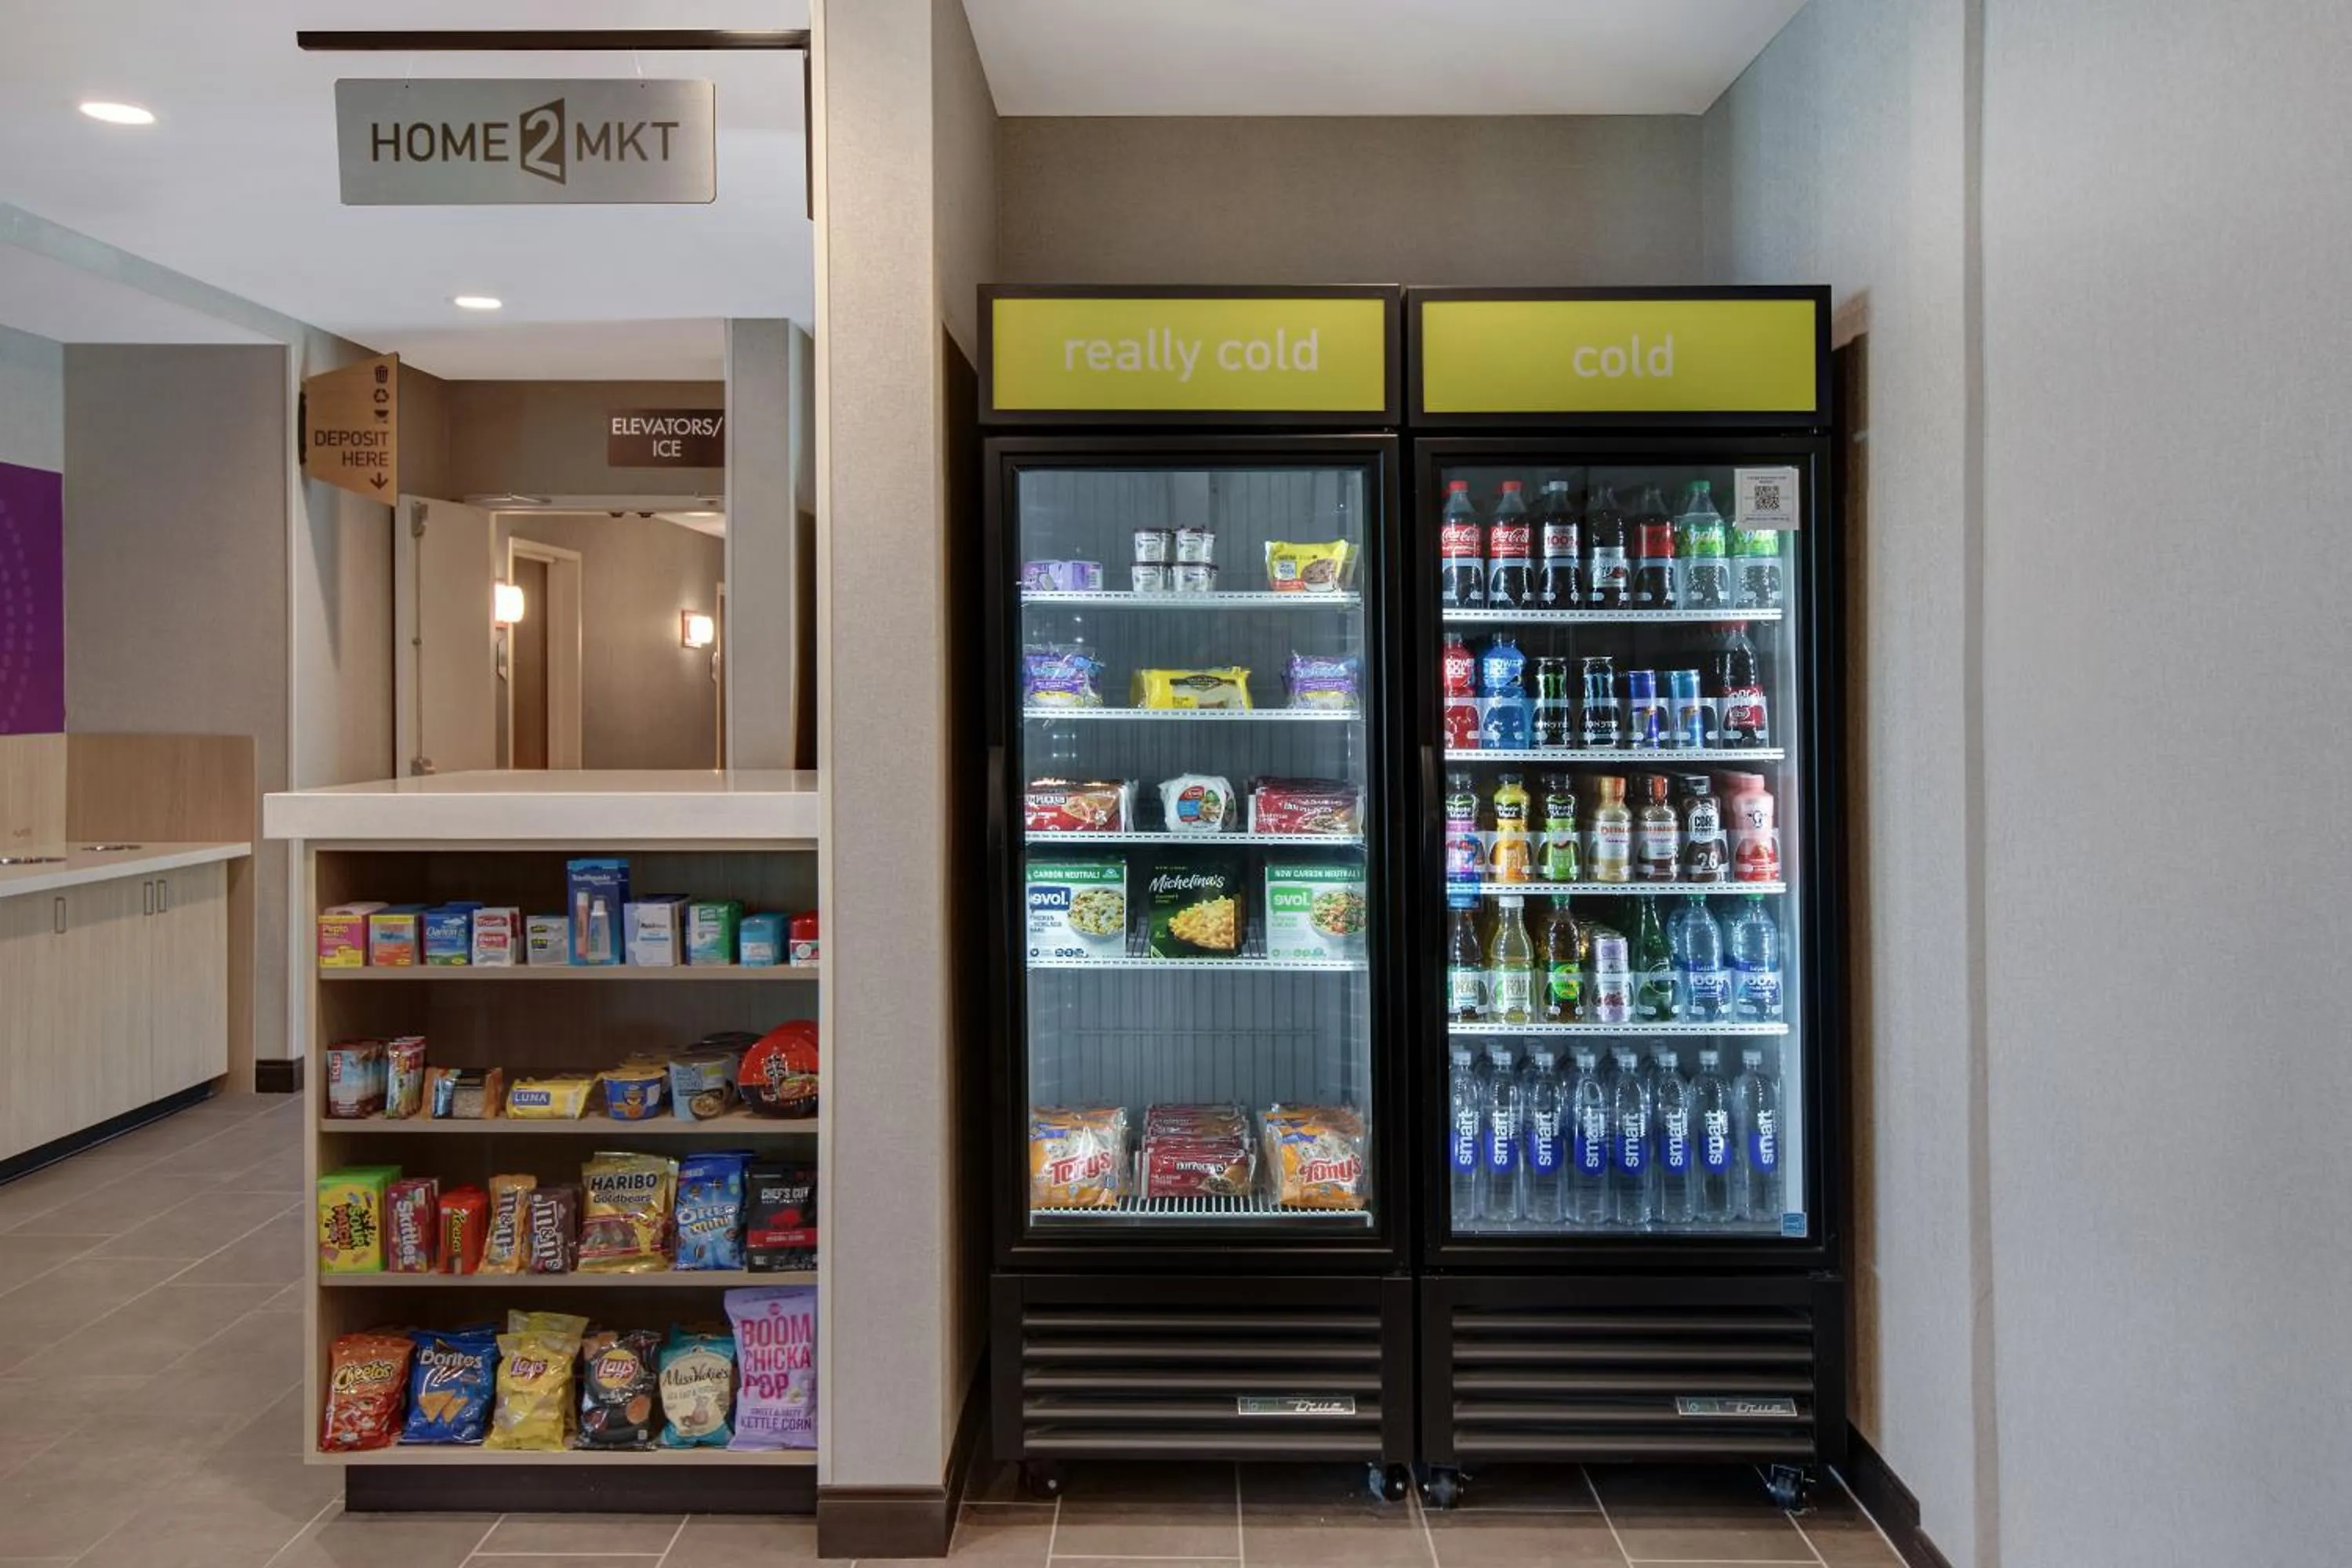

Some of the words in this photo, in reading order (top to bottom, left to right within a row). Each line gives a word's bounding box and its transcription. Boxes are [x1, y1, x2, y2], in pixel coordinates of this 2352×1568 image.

[371, 122, 509, 162] HOME
[576, 122, 679, 162] MKT
[1063, 328, 1202, 383] really
[1217, 328, 1318, 372] cold
[1572, 334, 1674, 378] cold
[314, 430, 389, 448] DEPOSIT
[612, 417, 722, 437] ELEVATORS/
[342, 450, 389, 467] HERE
[652, 441, 681, 458] ICE
[1149, 873, 1225, 892] Michelina's
[514, 1091, 547, 1102] LUNA
[1458, 1108, 1473, 1165] smart
[1493, 1109, 1508, 1166] smart
[1537, 1111, 1552, 1167] smart
[1584, 1111, 1599, 1167] smart
[1624, 1112, 1639, 1167] smart
[1667, 1109, 1683, 1167] smart
[1705, 1109, 1723, 1165] smart
[1758, 1109, 1773, 1165] smart
[590, 1174, 657, 1191] HARIBO
[593, 1193, 652, 1204] Goldbears
[349, 1205, 366, 1247] SOUR
[396, 1200, 419, 1265] Skittles
[690, 1215, 734, 1233] mini
[740, 1313, 811, 1347] BOOM
[419, 1347, 483, 1368] Doritos
[744, 1345, 811, 1372] CHICKA
[333, 1359, 394, 1391] Cheetos
[742, 1373, 789, 1399] POP
[741, 1417, 779, 1430] KETTLE
[781, 1417, 811, 1431] CORN
